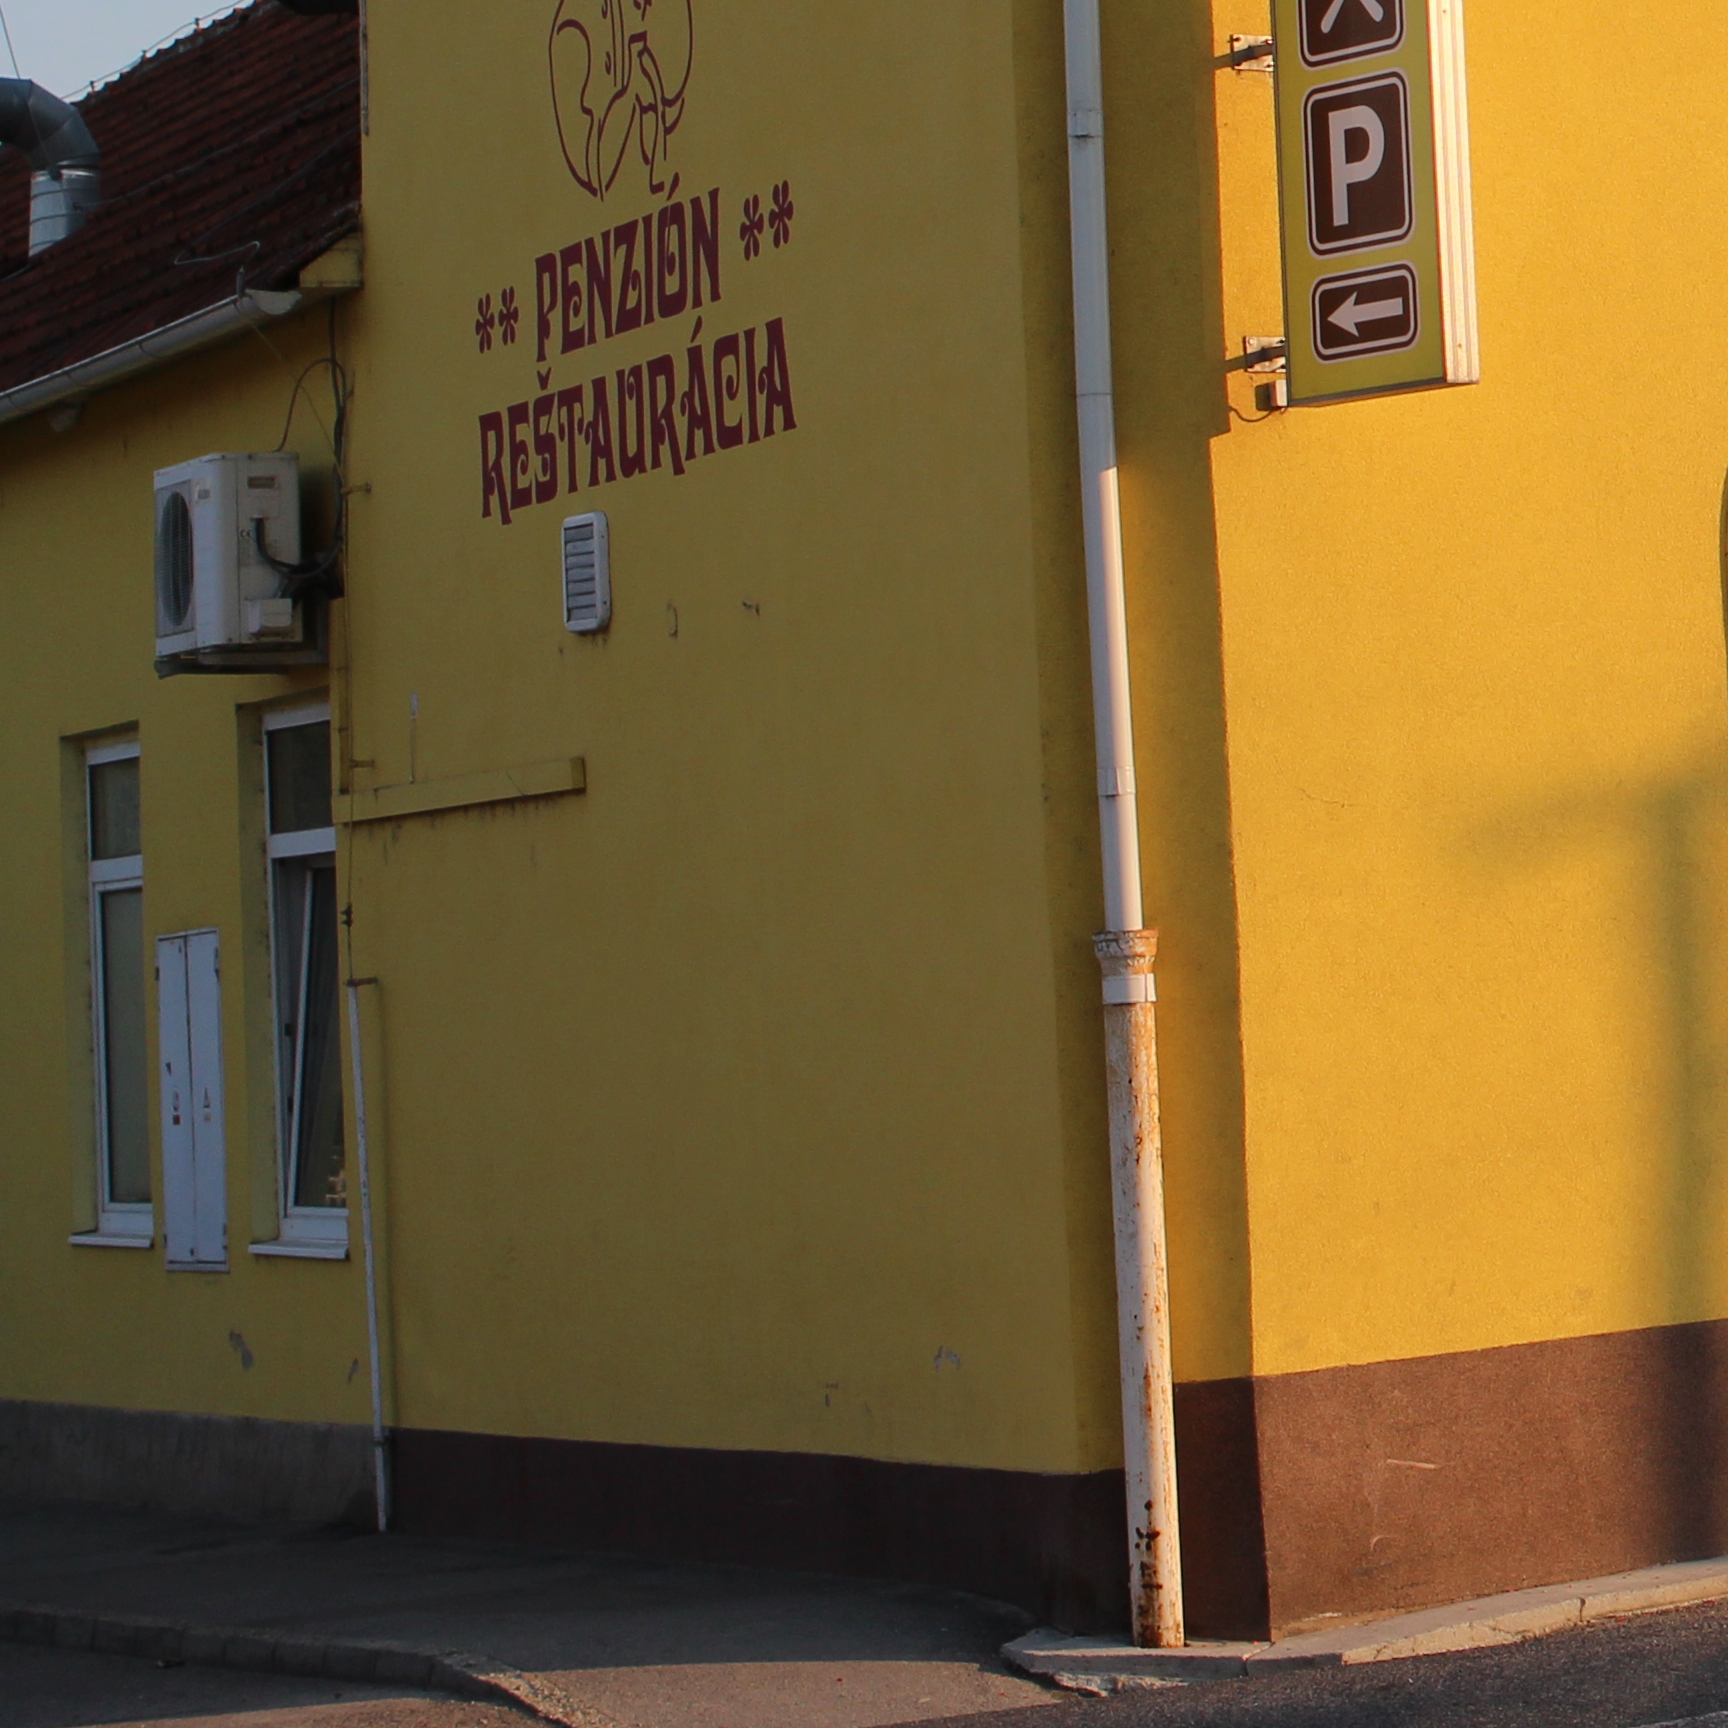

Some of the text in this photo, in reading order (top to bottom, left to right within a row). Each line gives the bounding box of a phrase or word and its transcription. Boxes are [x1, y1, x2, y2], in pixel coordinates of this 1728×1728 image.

[1327, 103, 1385, 227] P
[534, 171, 722, 364] PENZIÓN
[478, 315, 798, 526] REŠTAURÁCIA
